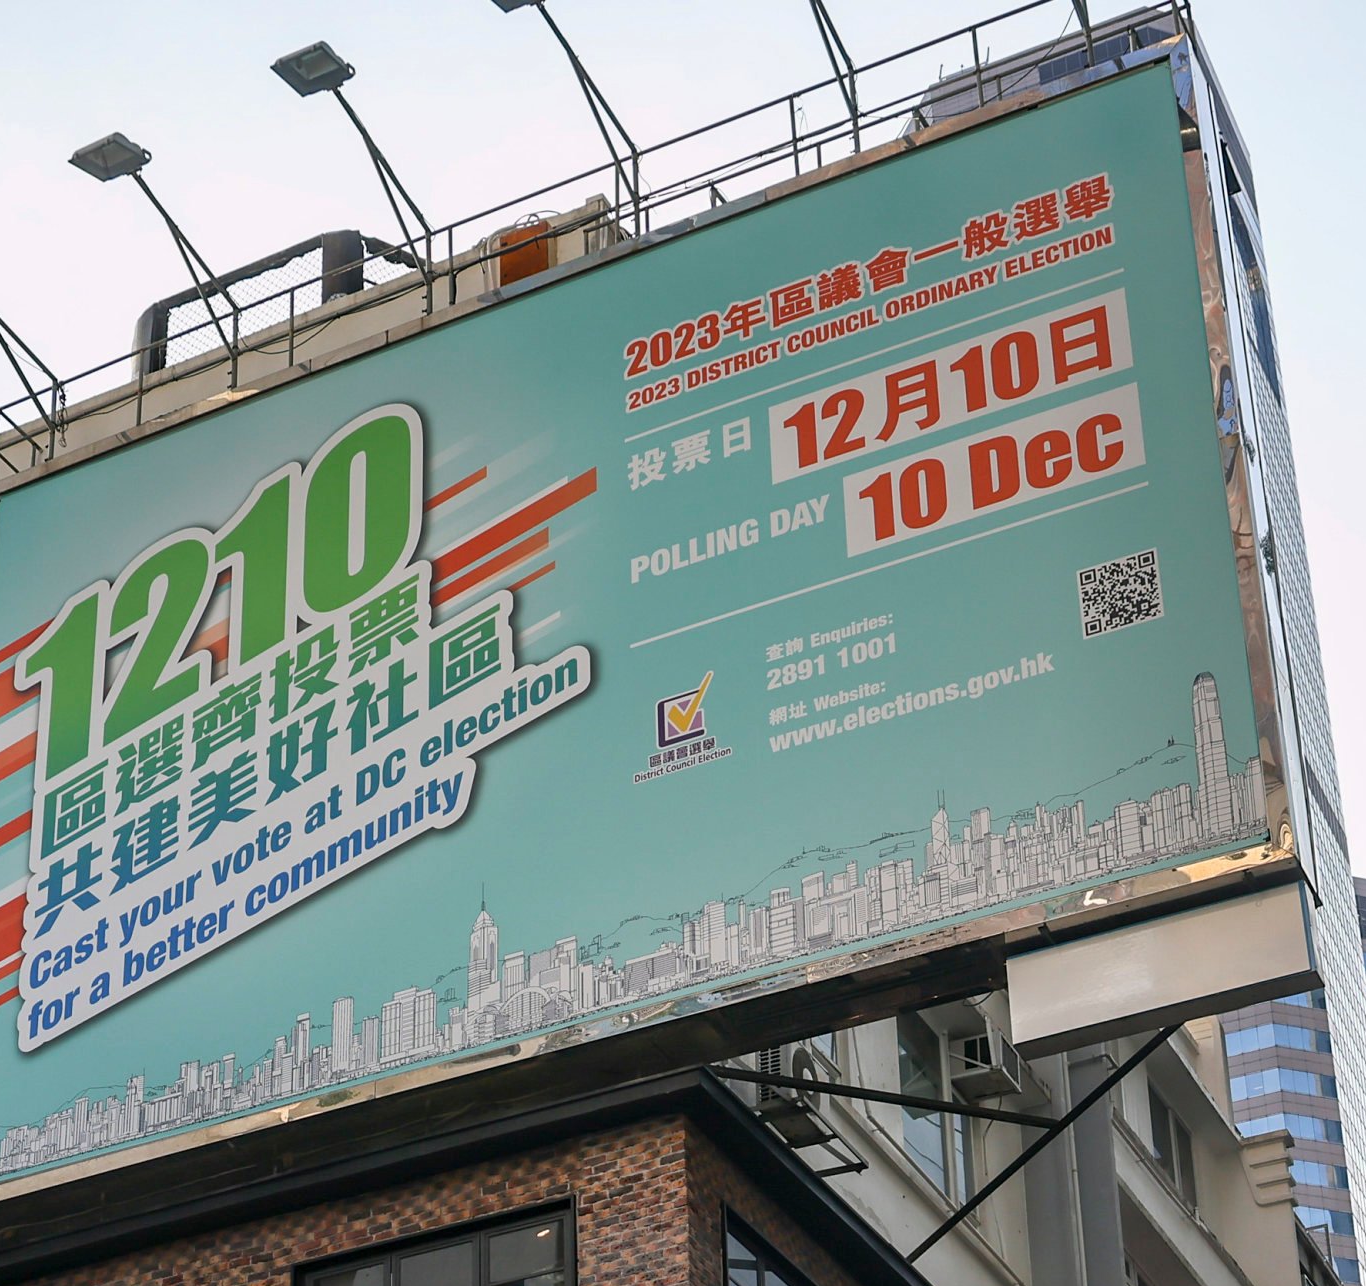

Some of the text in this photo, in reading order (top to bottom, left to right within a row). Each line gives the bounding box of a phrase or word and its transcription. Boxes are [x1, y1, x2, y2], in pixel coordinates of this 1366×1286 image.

[625, 174, 1112, 377] 2023年區議會一般選舉
[628, 226, 1112, 410] 2023 DISTRICT COUNCIL ORDINARY ELECTION
[784, 304, 1113, 470] 12月10日
[631, 413, 1124, 584] POLLING DAY 10 Dec
[25, 414, 413, 781] 1210
[766, 632, 897, 690] 2891 1001
[810, 613, 893, 648] Enquiries:
[33, 603, 501, 940] 共建美好社區
[41, 573, 420, 860] 區選齊投票
[635, 748, 731, 782] District Council Election
[769, 652, 1055, 753] www.elections.gov.hk
[813, 681, 886, 711] Website:
[28, 771, 464, 1040] for a better community
[30, 656, 578, 990] Cast your vote at DC election
